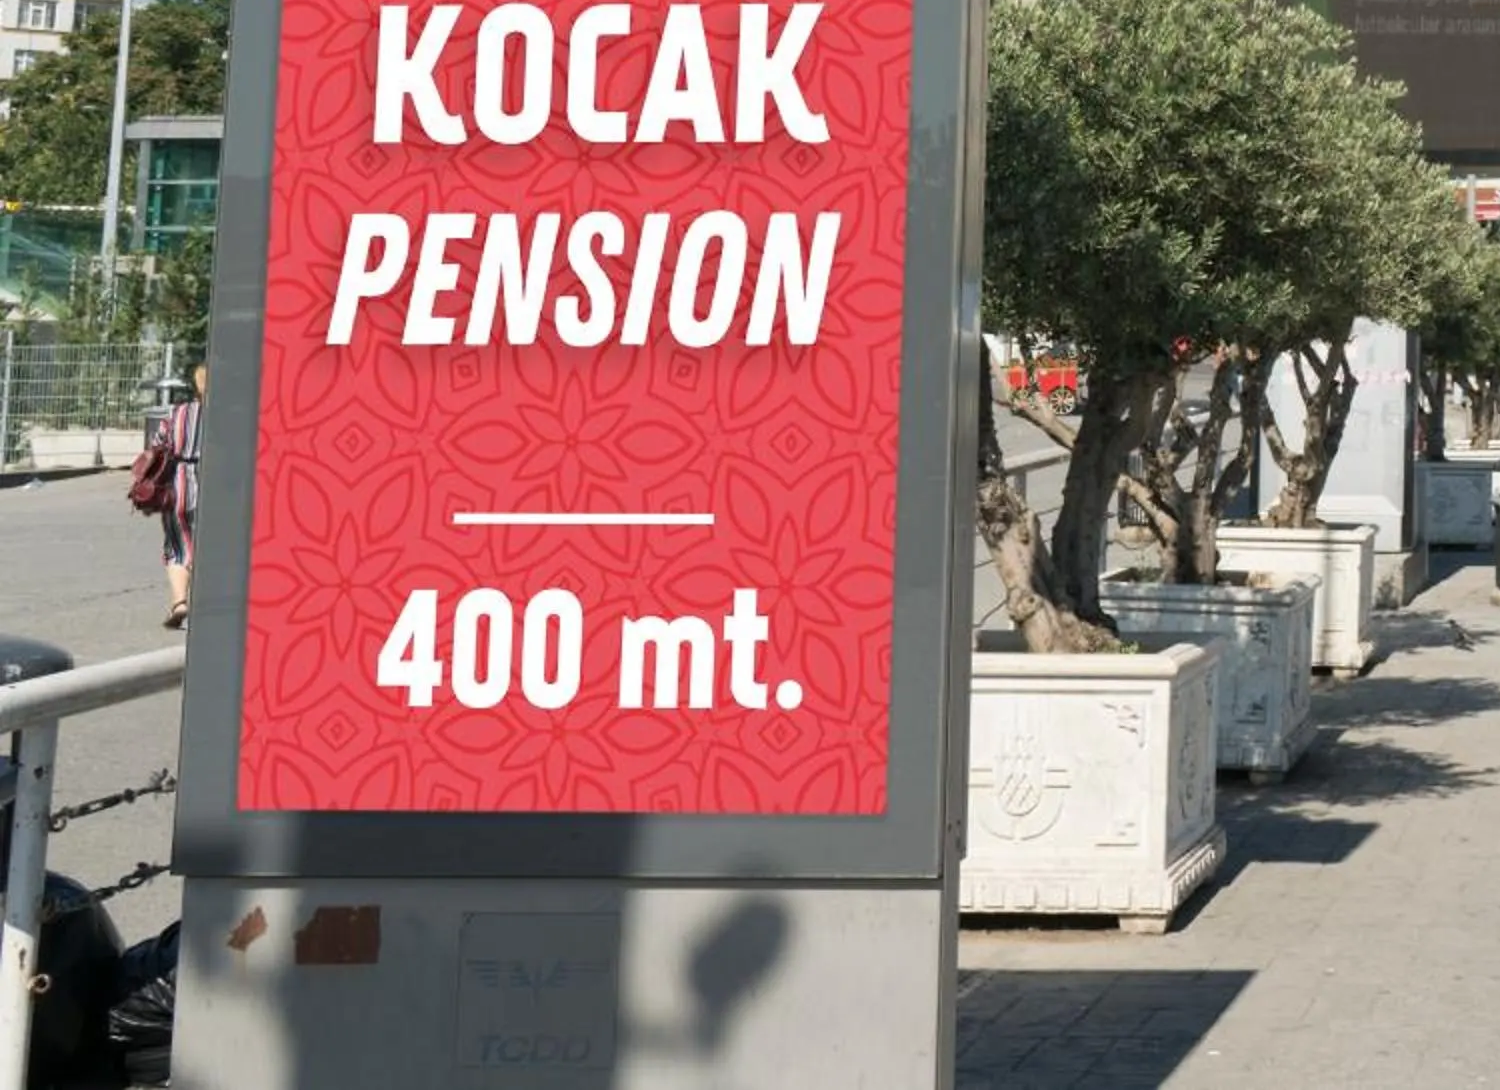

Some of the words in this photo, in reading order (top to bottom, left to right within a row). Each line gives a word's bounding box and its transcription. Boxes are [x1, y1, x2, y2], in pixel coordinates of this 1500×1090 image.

[373, 3, 830, 144] KOCAK
[327, 210, 842, 348] PENSION
[376, 587, 583, 709] 400
[618, 588, 803, 709] mt.
